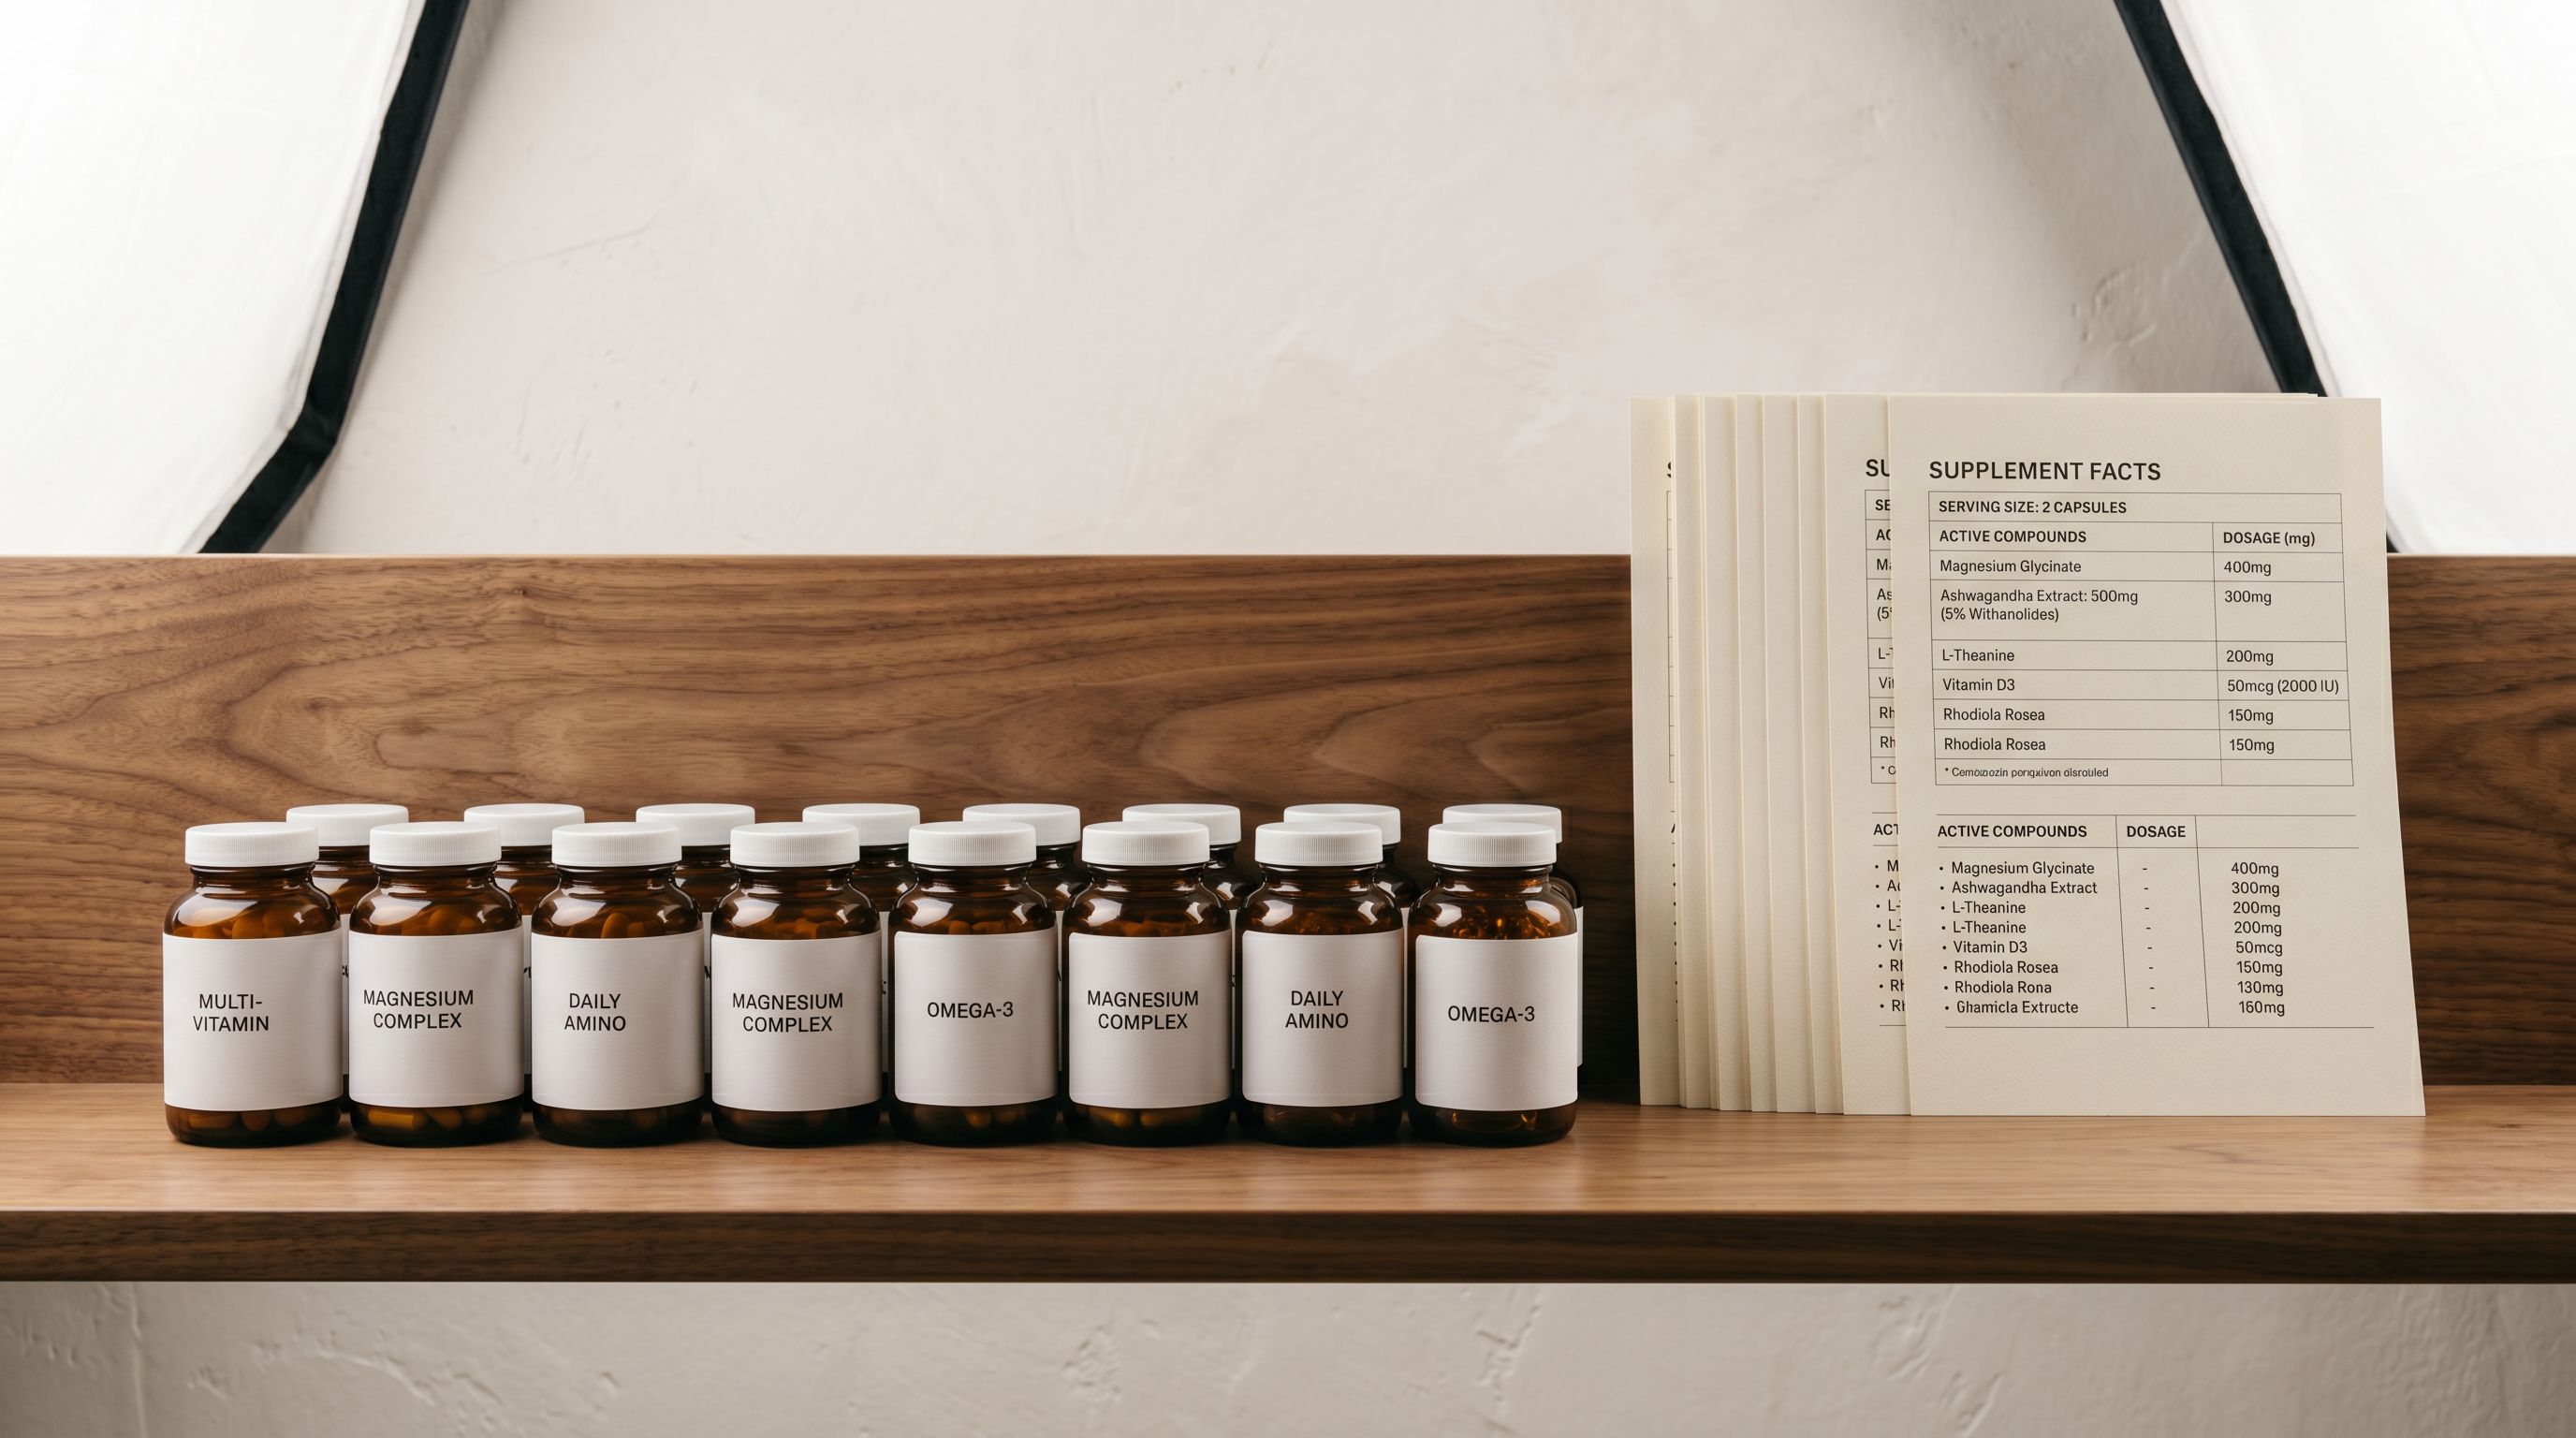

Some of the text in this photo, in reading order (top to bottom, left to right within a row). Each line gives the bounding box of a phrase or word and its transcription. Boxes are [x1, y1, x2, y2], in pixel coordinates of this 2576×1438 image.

[1928, 460, 2161, 481] SUPPLEMENT FACTS
[1939, 500, 2128, 514] SERVING SIZE: 2 CAPSULES
[1939, 529, 2087, 543] ACTIVE COMPOUNDS
[2223, 531, 2316, 548] DOSAGE (mg)
[1939, 559, 2082, 576] Magnesium Glycinate
[2223, 560, 2272, 578] 400mg
[1939, 588, 2139, 606] Ashwagandha Extract: 500mg
[2224, 590, 2272, 607] 300mg
[1940, 606, 2059, 624] (5% Withanolides)
[1941, 648, 2015, 662] L-Theanine
[2226, 649, 2274, 667] 200mg
[1941, 677, 2015, 692] Vitamin D3
[2227, 678, 2339, 697] 50mcg (2000 IU)
[1943, 707, 2045, 722] Rhodiola Rosea
[2228, 708, 2274, 726] 150mg
[1944, 736, 2046, 751] Rhodiola Rosea
[2229, 738, 2275, 756] 150mg
[1937, 824, 2087, 838] ACTIVE COMPOUNDS
[2126, 825, 2187, 839] DOSAGE
[1951, 860, 2095, 878] Magnesium Glycinate
[2231, 861, 2279, 878] 400mg
[1951, 879, 2099, 898] Ashwagandha Extract
[2231, 881, 2280, 899] 300mg
[1952, 900, 2027, 915] L-Theanine
[2232, 901, 2281, 918] 200mg
[1953, 919, 2027, 934] L-Theanine
[2233, 920, 2282, 938] 200mg
[1953, 939, 2028, 954] Vitamin D3
[2235, 940, 2283, 958] 50mcg
[1954, 959, 2059, 975] Rhodiola Rosea
[2236, 960, 2283, 977] 150mg
[1954, 979, 2053, 994] Rhodiola Rona
[2237, 980, 2284, 997] 130mg
[198, 992, 263, 1010] MULTI-
[363, 989, 474, 1007] MAGNESIUM
[569, 992, 622, 1009] DAILY
[732, 991, 843, 1011] MAGNESIUM
[1087, 990, 1199, 1008] MAGNESIUM
[1291, 990, 1344, 1007] DAILY
[927, 1001, 1014, 1020] OMEGA-3
[1447, 1005, 1536, 1023] OMEGA-3
[192, 1015, 270, 1033] VITAMIN
[373, 1012, 462, 1030] COMPLEX
[564, 1015, 627, 1032] AMINO
[742, 1015, 833, 1034] COMPLEX
[1097, 1012, 1189, 1031] COMPLEX
[1284, 1012, 1349, 1030] AMINO
